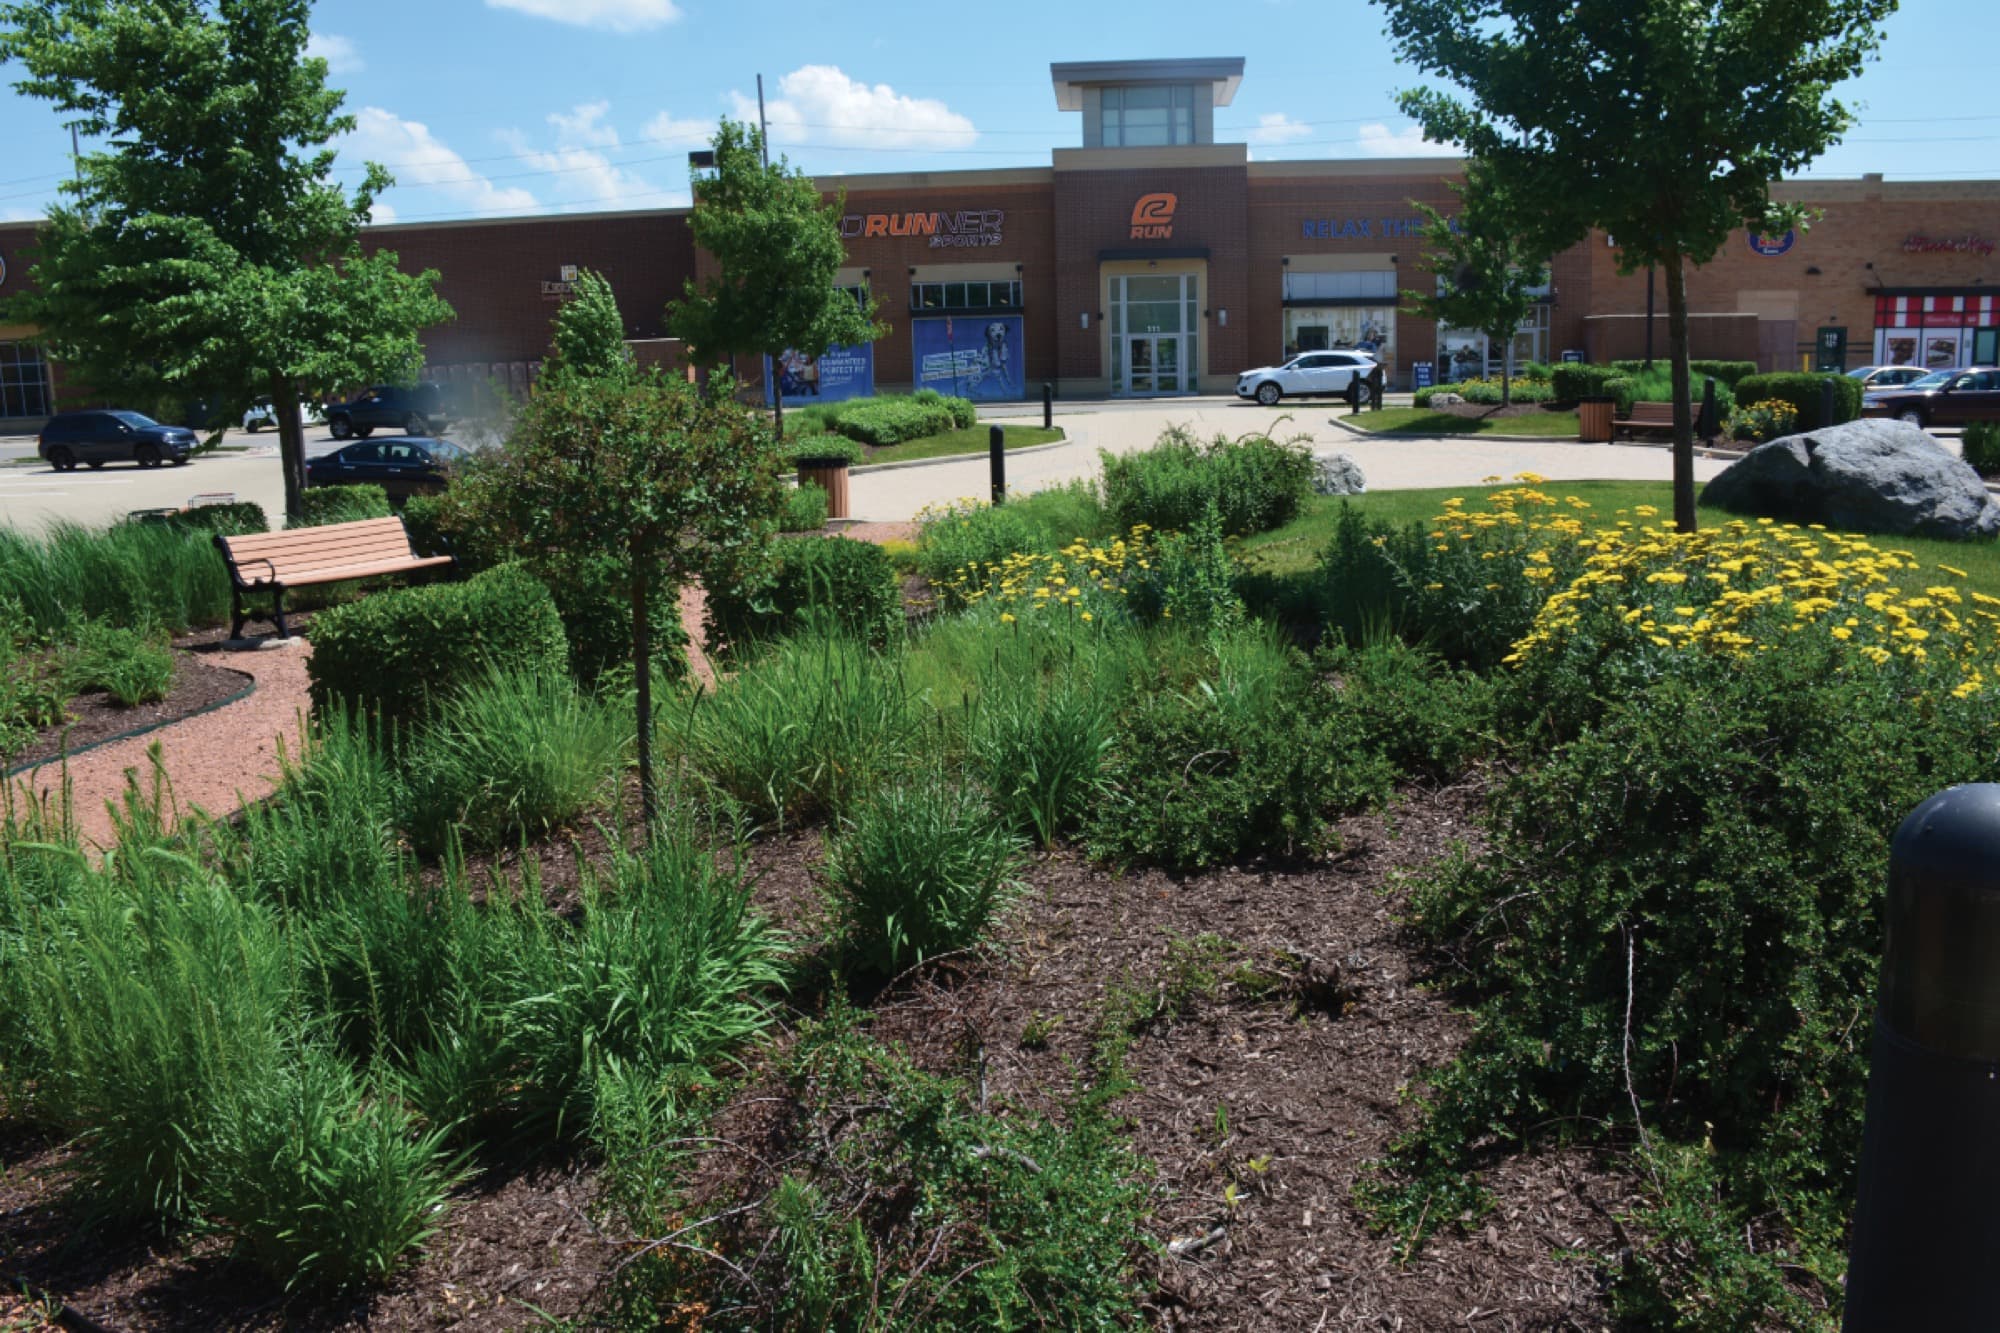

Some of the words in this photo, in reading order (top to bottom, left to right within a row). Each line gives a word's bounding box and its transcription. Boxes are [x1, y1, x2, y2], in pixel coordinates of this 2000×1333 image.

[1130, 225, 1172, 239] RUN
[1302, 218, 1372, 239] RELAX
[1379, 217, 1425, 238] THE
[928, 234, 1003, 248] SPORTS
